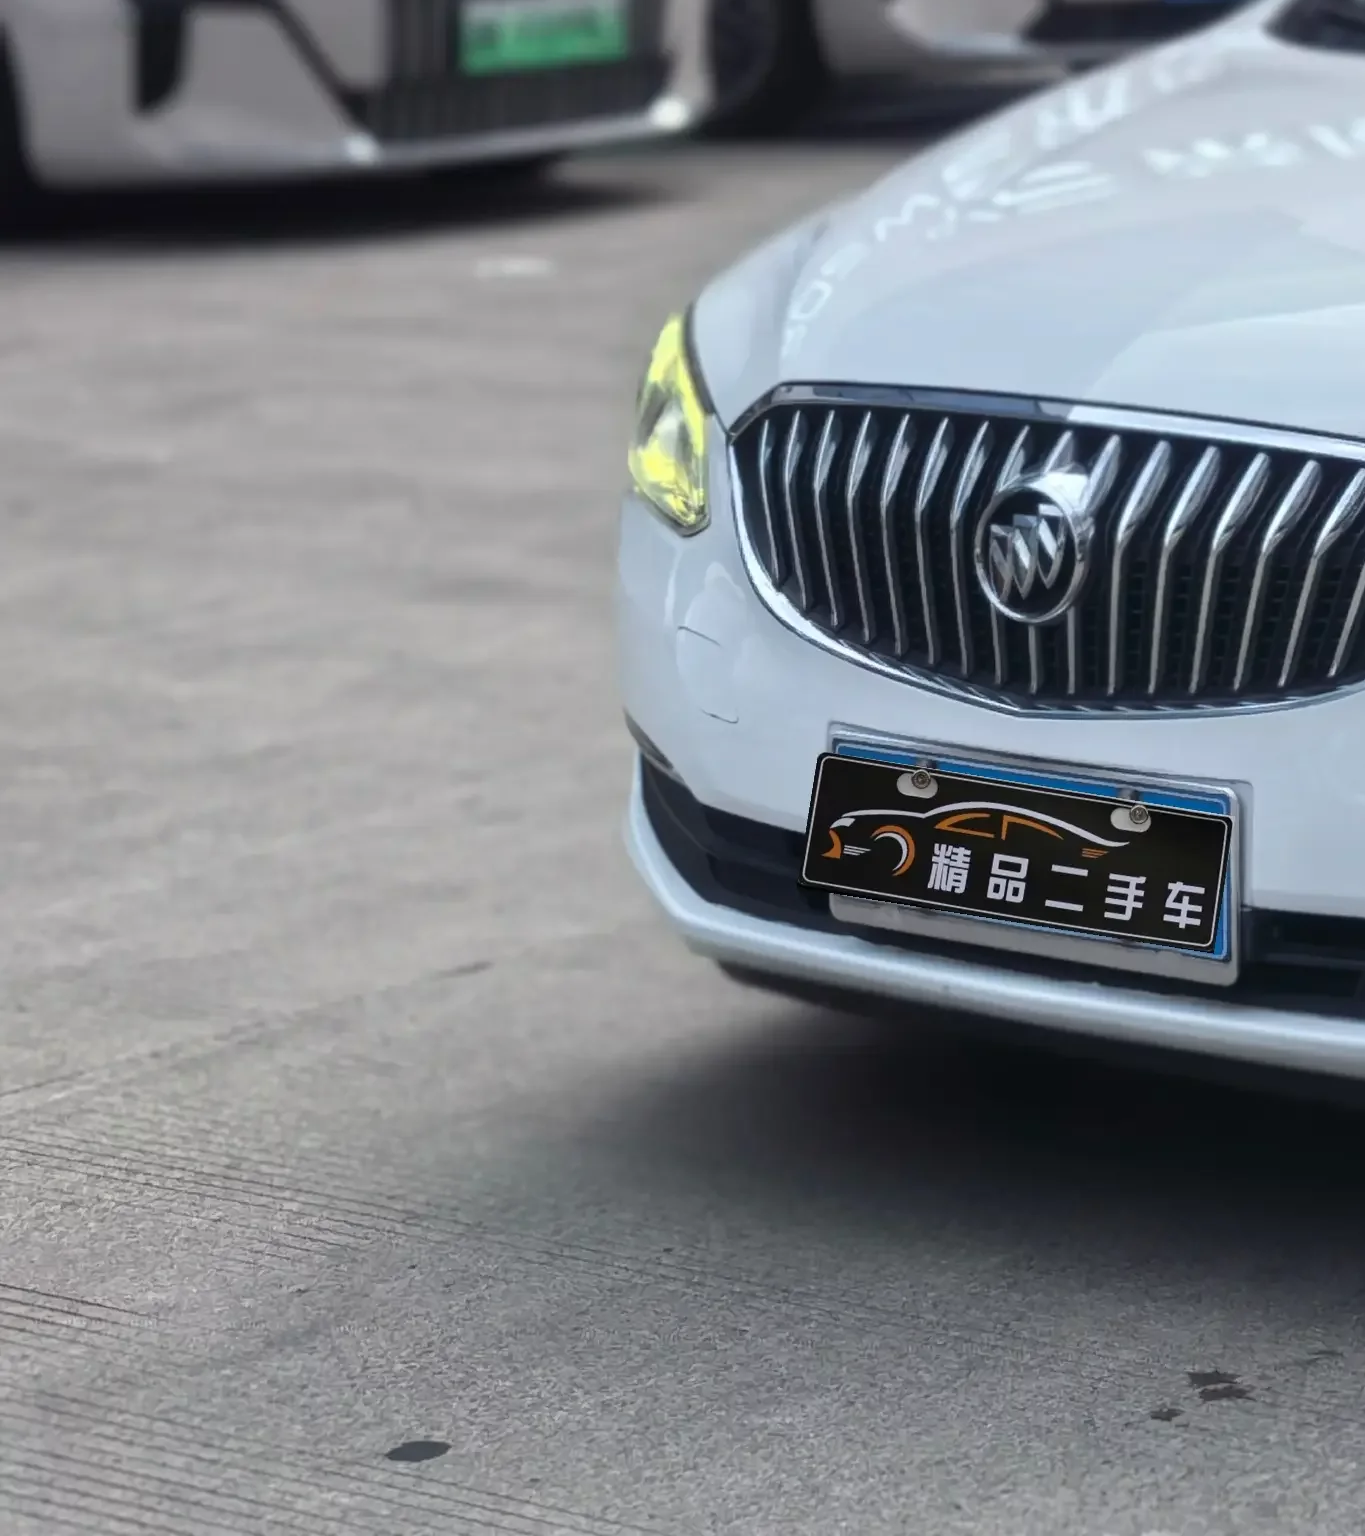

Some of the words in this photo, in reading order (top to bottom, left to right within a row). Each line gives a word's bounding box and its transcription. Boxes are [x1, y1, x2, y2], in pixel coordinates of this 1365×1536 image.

[926, 842, 1206, 930] 精品二手车
